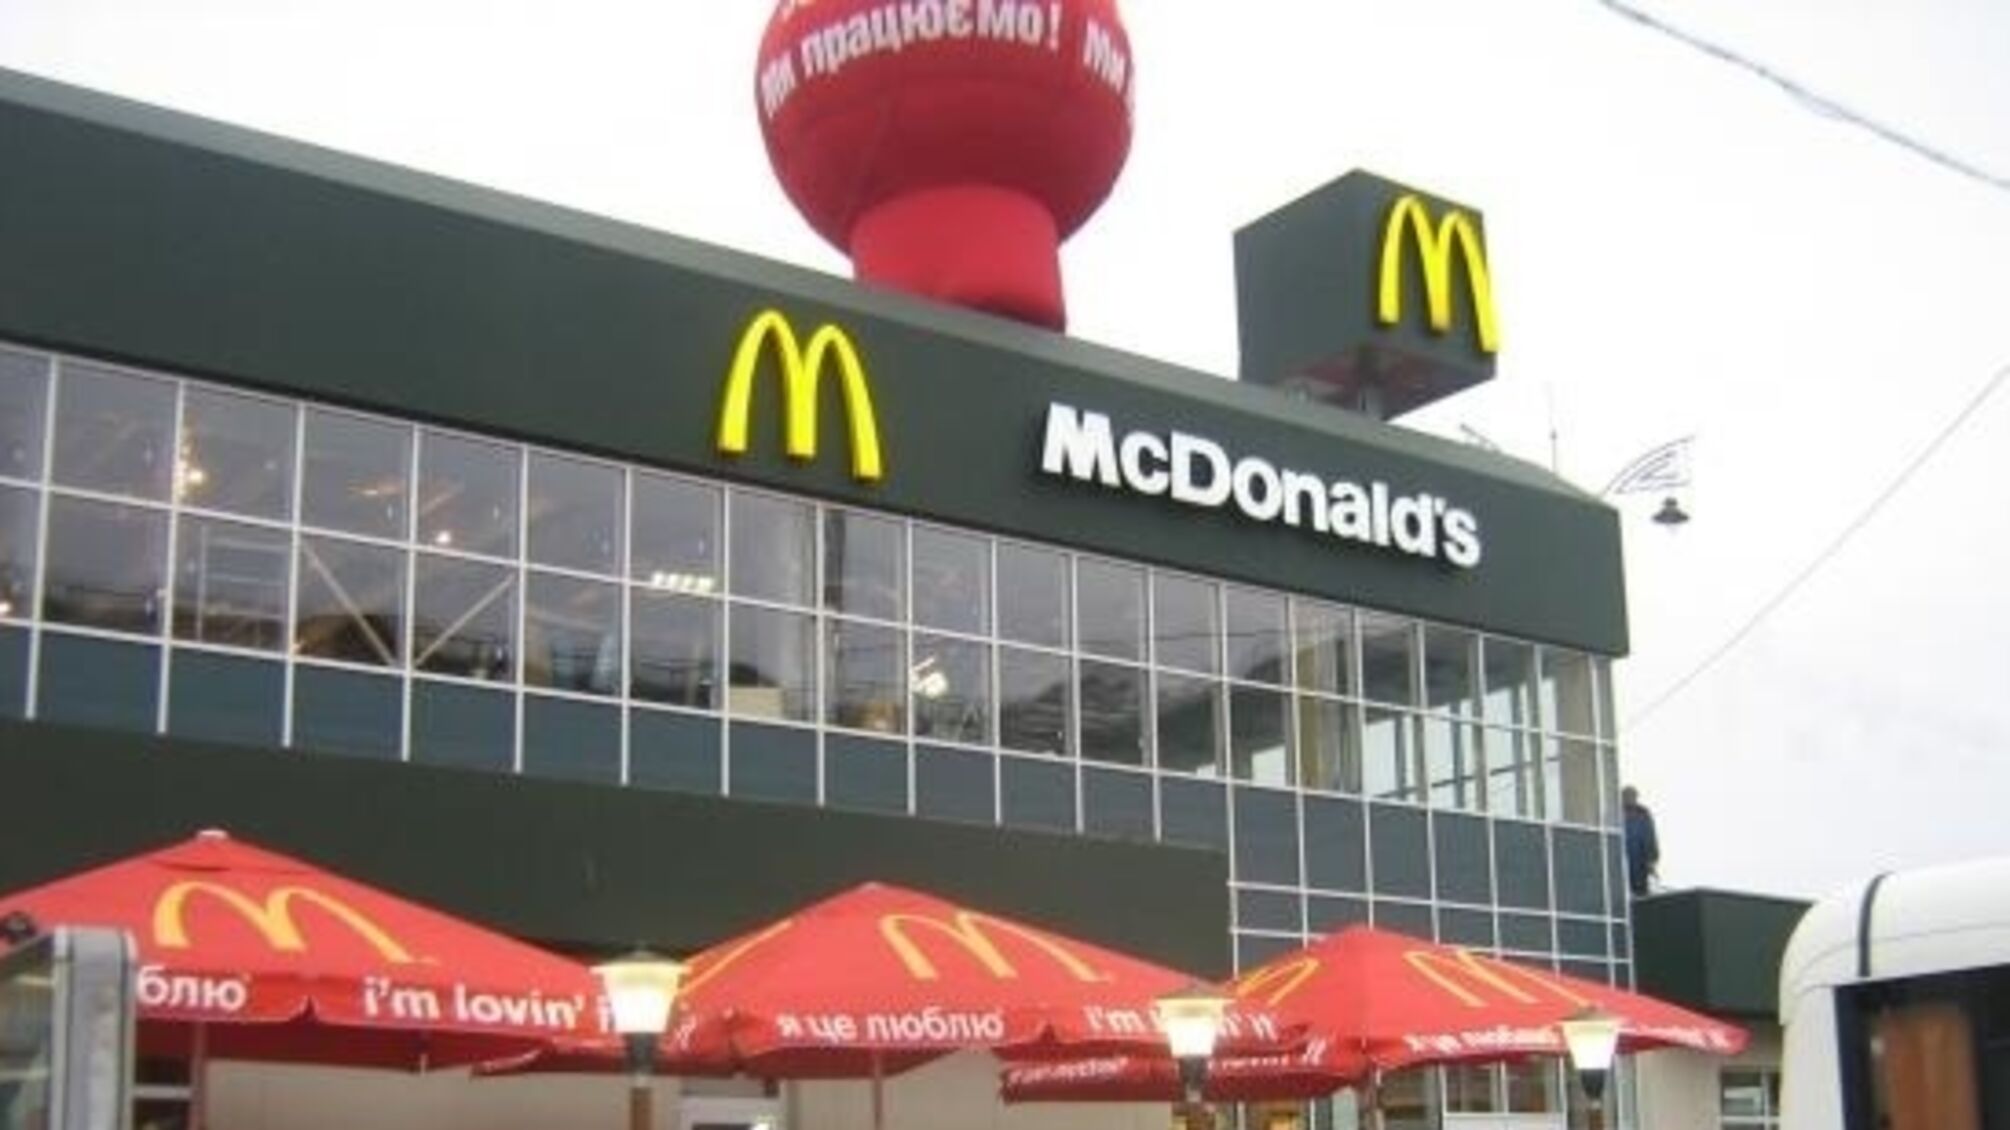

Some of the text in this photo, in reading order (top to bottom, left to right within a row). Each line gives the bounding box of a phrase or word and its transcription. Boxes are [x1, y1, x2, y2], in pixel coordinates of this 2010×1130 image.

[1042, 402, 1481, 567] McDonald's
[137, 965, 247, 1011] блю
[454, 984, 585, 1029] lovin'
